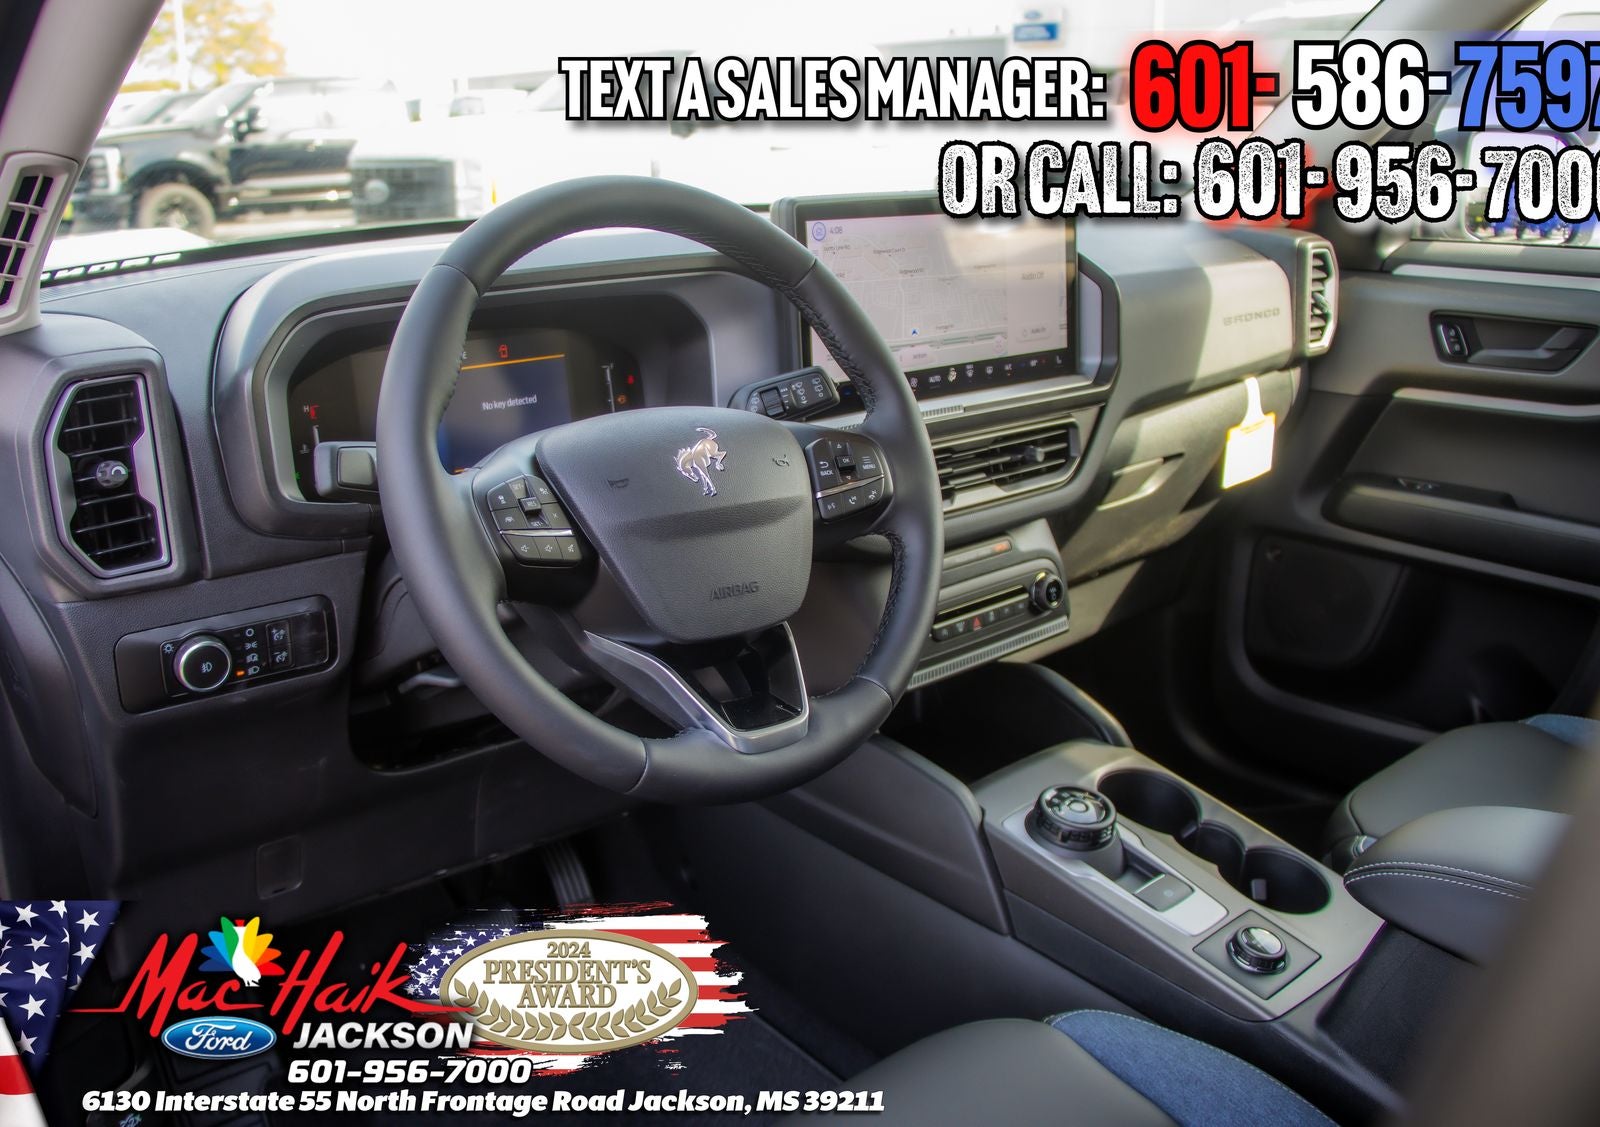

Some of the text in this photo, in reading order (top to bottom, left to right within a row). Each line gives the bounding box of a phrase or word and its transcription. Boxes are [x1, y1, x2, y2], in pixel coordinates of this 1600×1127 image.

[1223, 308, 1281, 326] BRONCO
[928, 375, 942, 383] AUTO
[482, 394, 537, 410] No key detected
[710, 581, 760, 601] AIRBAG
